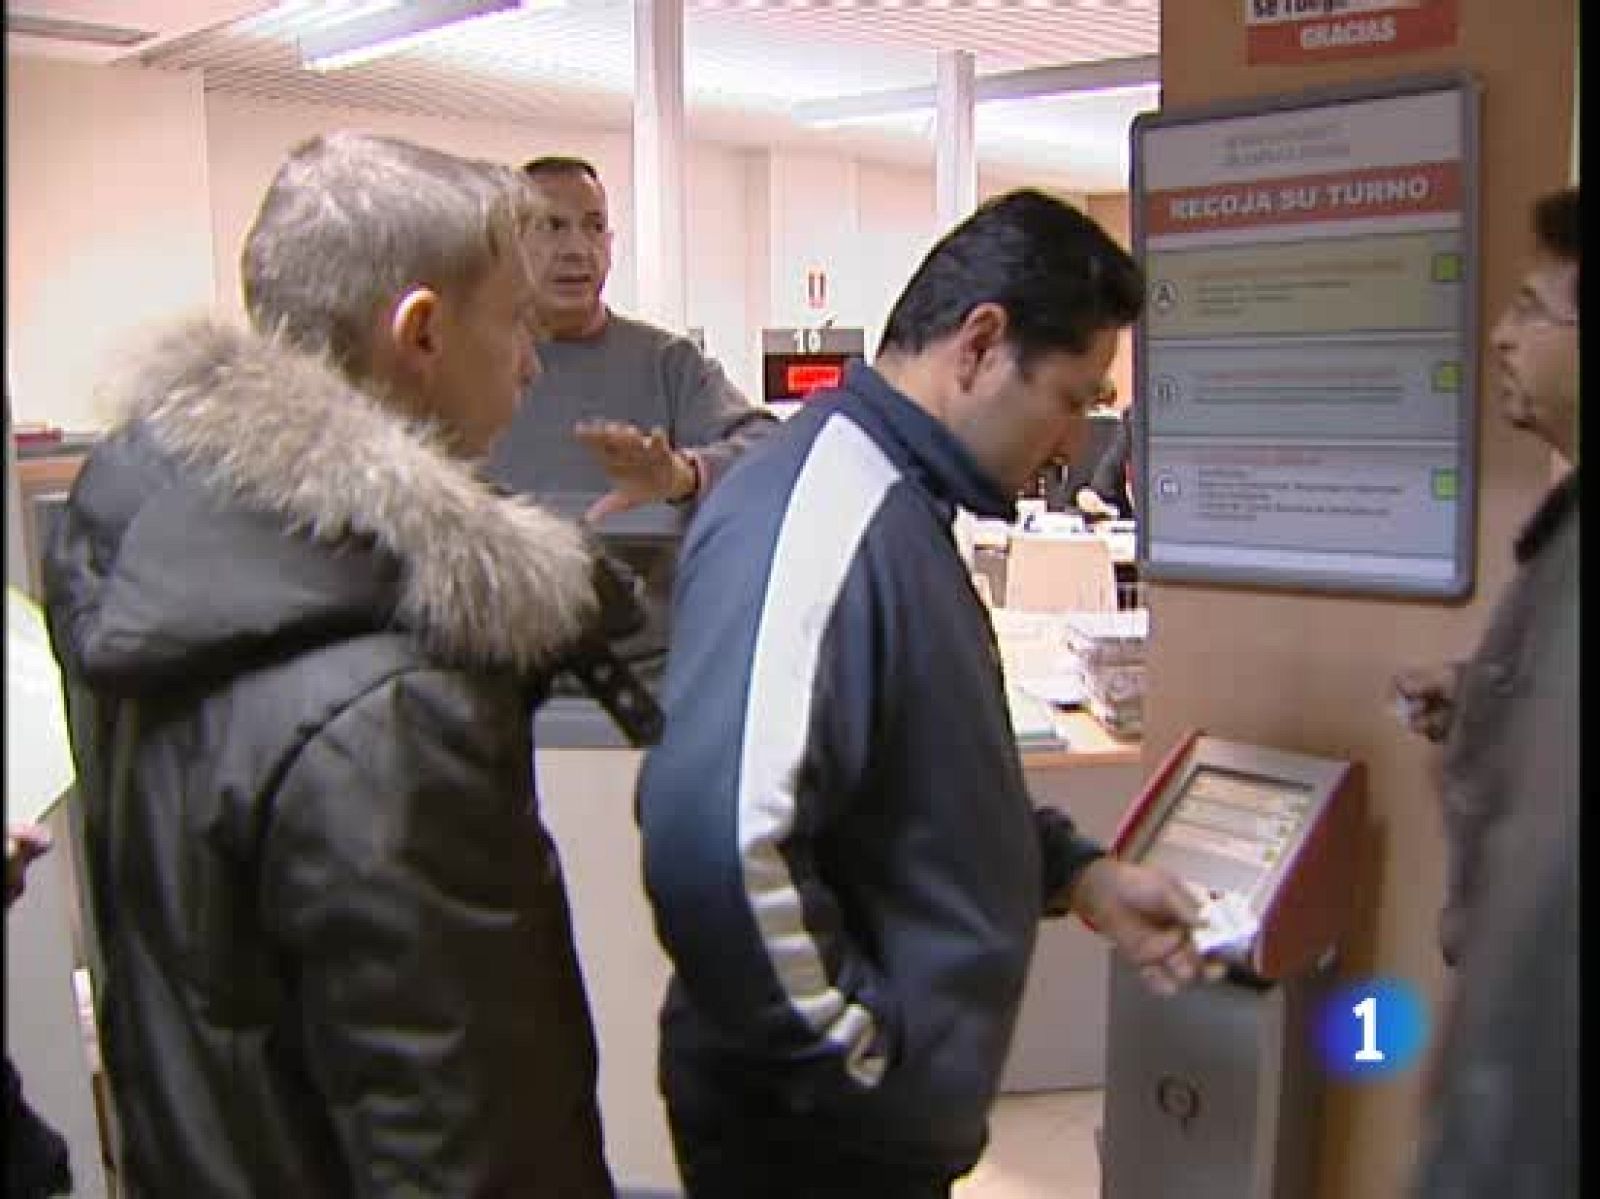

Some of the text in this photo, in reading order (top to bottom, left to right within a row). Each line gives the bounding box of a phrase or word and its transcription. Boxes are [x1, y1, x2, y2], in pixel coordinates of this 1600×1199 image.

[1302, 15, 1397, 48] GRACIAS
[1168, 174, 1430, 220] RECOJA SU TURNO
[794, 327, 821, 353] 10
